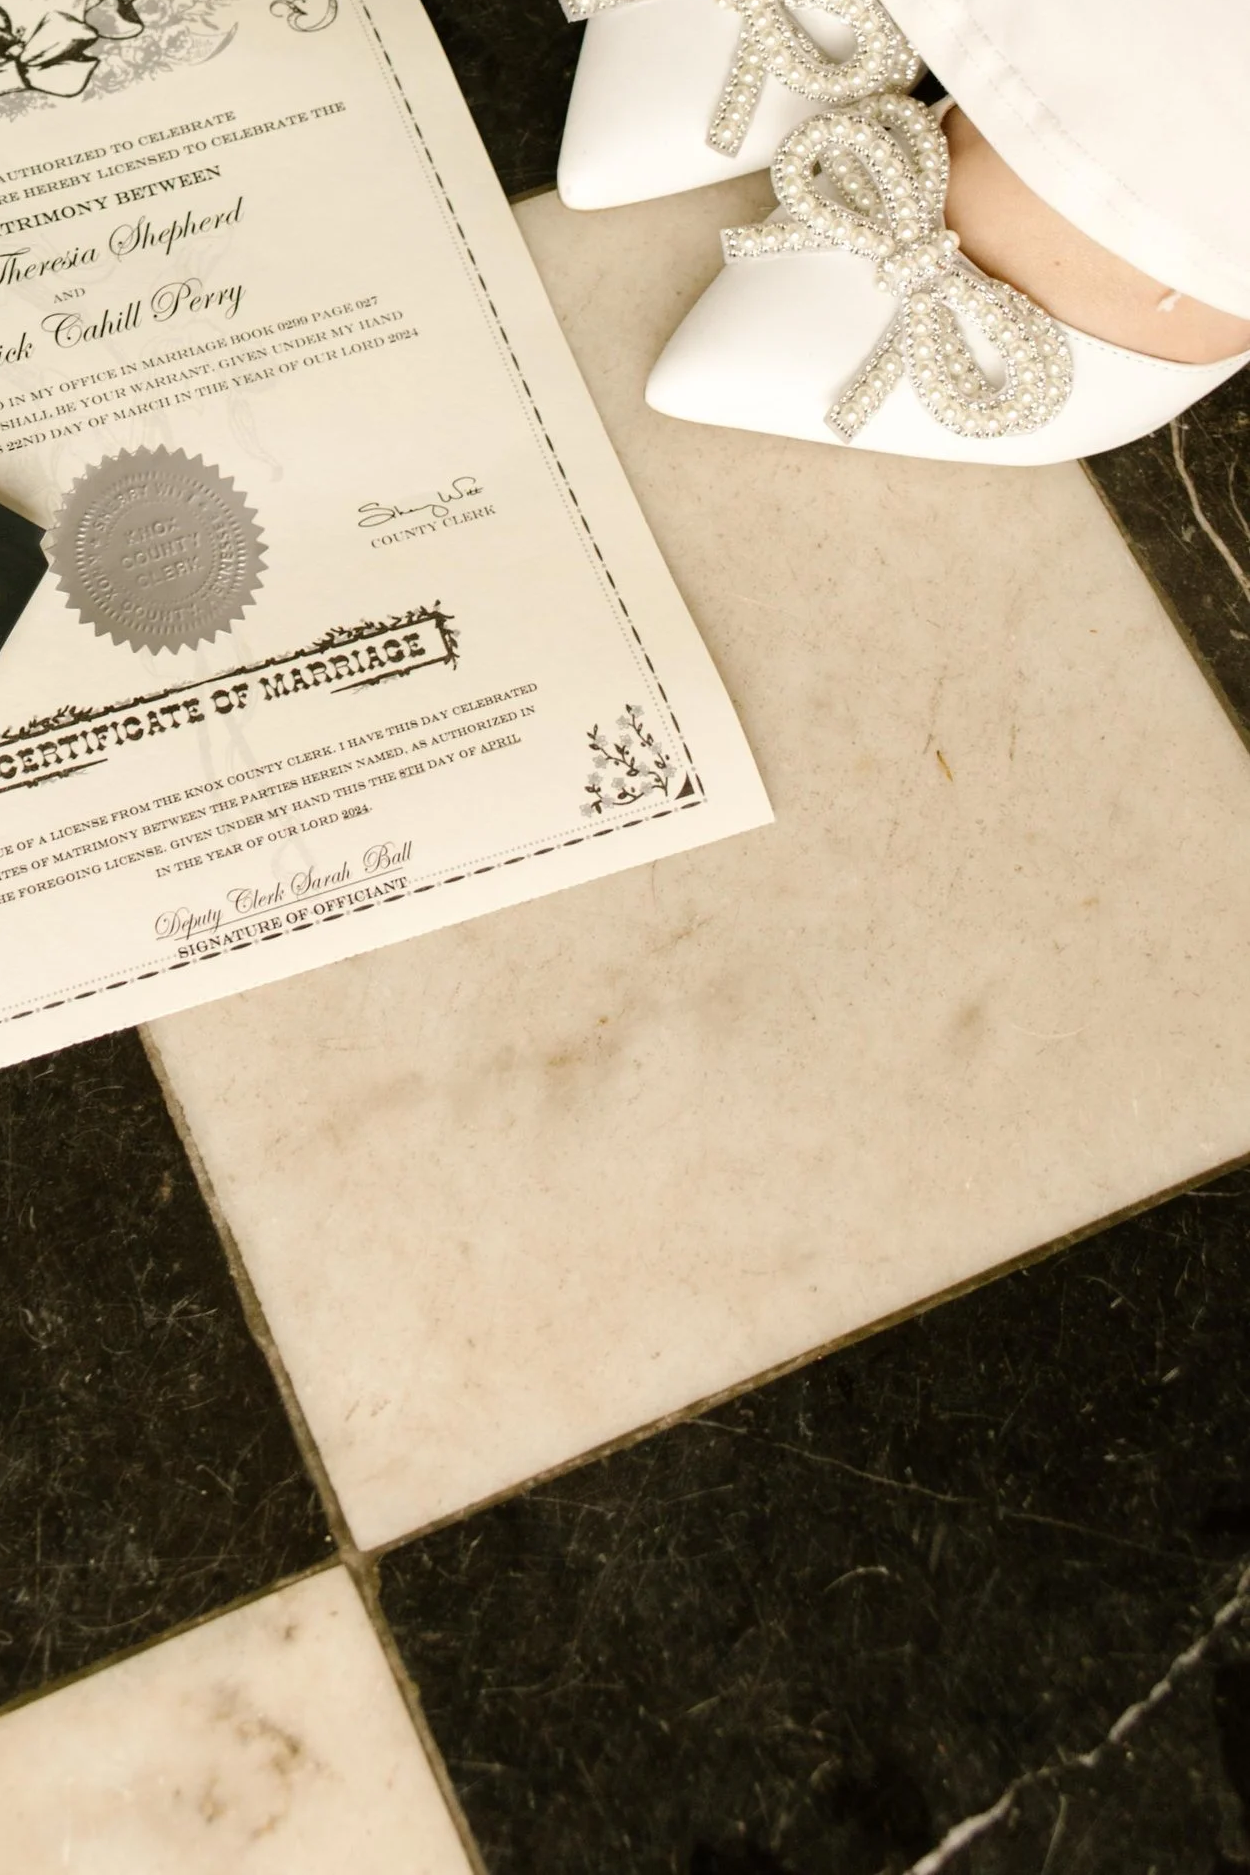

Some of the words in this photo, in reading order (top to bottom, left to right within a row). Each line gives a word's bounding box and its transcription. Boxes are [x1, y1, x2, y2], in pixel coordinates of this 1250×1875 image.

[23, 172, 90, 198] HEREBY
[97, 149, 179, 178] LICENSED
[183, 141, 206, 154] TO
[211, 112, 308, 145] CELEBRATE
[310, 102, 345, 117] THE
[110, 141, 133, 152] TO
[138, 111, 235, 145] CELEBRATE
[114, 165, 220, 204] BETWEEN
[109, 196, 245, 262] Shepherd
[41, 300, 142, 348] Cahill
[150, 278, 246, 322] Perry
[53, 287, 86, 304] AND
[0, 410, 52, 430] SHALL
[55, 402, 76, 415] BE
[80, 388, 125, 407] YOUR
[218, 348, 266, 368] GIVEN
[271, 332, 326, 353] UNDER
[330, 324, 352, 337] MY
[359, 311, 402, 329] HAND
[8, 394, 25, 406] IN
[30, 386, 52, 400] MY
[59, 369, 116, 391] OFFICE
[120, 363, 136, 375] IN
[142, 338, 226, 369] MARRIAGE
[230, 325, 273, 344] BOOK
[277, 316, 307, 330] 0299
[311, 302, 355, 323] PAGE
[355, 295, 380, 311] 027
[6, 433, 45, 451] 22ND
[50, 421, 81, 438] DAY
[88, 414, 108, 427] OF
[113, 397, 170, 420] MARCH
[174, 391, 191, 403] IN
[194, 381, 228, 396] THE
[231, 368, 274, 385] YEAR
[278, 360, 297, 372] OF
[303, 350, 337, 365] OUR
[341, 337, 384, 355] LORD
[388, 328, 417, 342] 2024
[121, 531, 200, 569] COUNTY
[125, 516, 177, 546] KNOX
[371, 521, 435, 547] COUNTY
[442, 505, 495, 526] CLERK
[137, 555, 202, 588] CLERK
[210, 684, 250, 715] OF
[257, 632, 425, 702] MARRIAGE
[16, 838, 33, 850] OF
[39, 836, 46, 844] A
[50, 815, 108, 840] LICENSE
[110, 802, 150, 821] FROM
[152, 793, 181, 807] THE
[184, 779, 223, 798] KNOX
[227, 760, 281, 784] COUNTY
[339, 742, 344, 750] I
[347, 730, 383, 747] HAVE
[385, 720, 418, 735] THIS
[420, 709, 447, 725] DAY
[452, 683, 537, 714] CELEBRATED
[31, 857, 48, 869] OF
[52, 829, 137, 863] MATRIMONY
[142, 807, 205, 835] BETWEEN
[209, 798, 237, 813] THE
[240, 779, 298, 804] PARTIES
[301, 762, 352, 785] HEREIN
[412, 739, 427, 751] AS
[431, 711, 517, 745] AUTHORIZED
[520, 705, 534, 716] IN
[18, 864, 101, 897] FOREGOING
[170, 829, 211, 849] GIVEN
[215, 813, 264, 834] UNDER
[266, 805, 286, 819] MY
[291, 793, 330, 811] HAND
[332, 781, 366, 797] THIS
[368, 772, 396, 786] THE
[398, 762, 425, 778] 8TH
[427, 753, 453, 768] DAY
[459, 746, 475, 758] OF
[481, 734, 520, 753] APRIL
[155, 865, 170, 877] IN
[173, 855, 202, 871] THE
[205, 843, 242, 860] YEAR
[246, 836, 263, 847] OF
[267, 826, 298, 841] OUR
[300, 813, 338, 831] LORD
[155, 907, 223, 941] Deputy
[227, 883, 284, 913] Clerk
[290, 861, 351, 898] Sarah
[363, 840, 412, 874] Ball
[177, 916, 283, 959] SIGNATURE
[286, 907, 310, 924] OF
[313, 876, 409, 916] OFFICIANT
